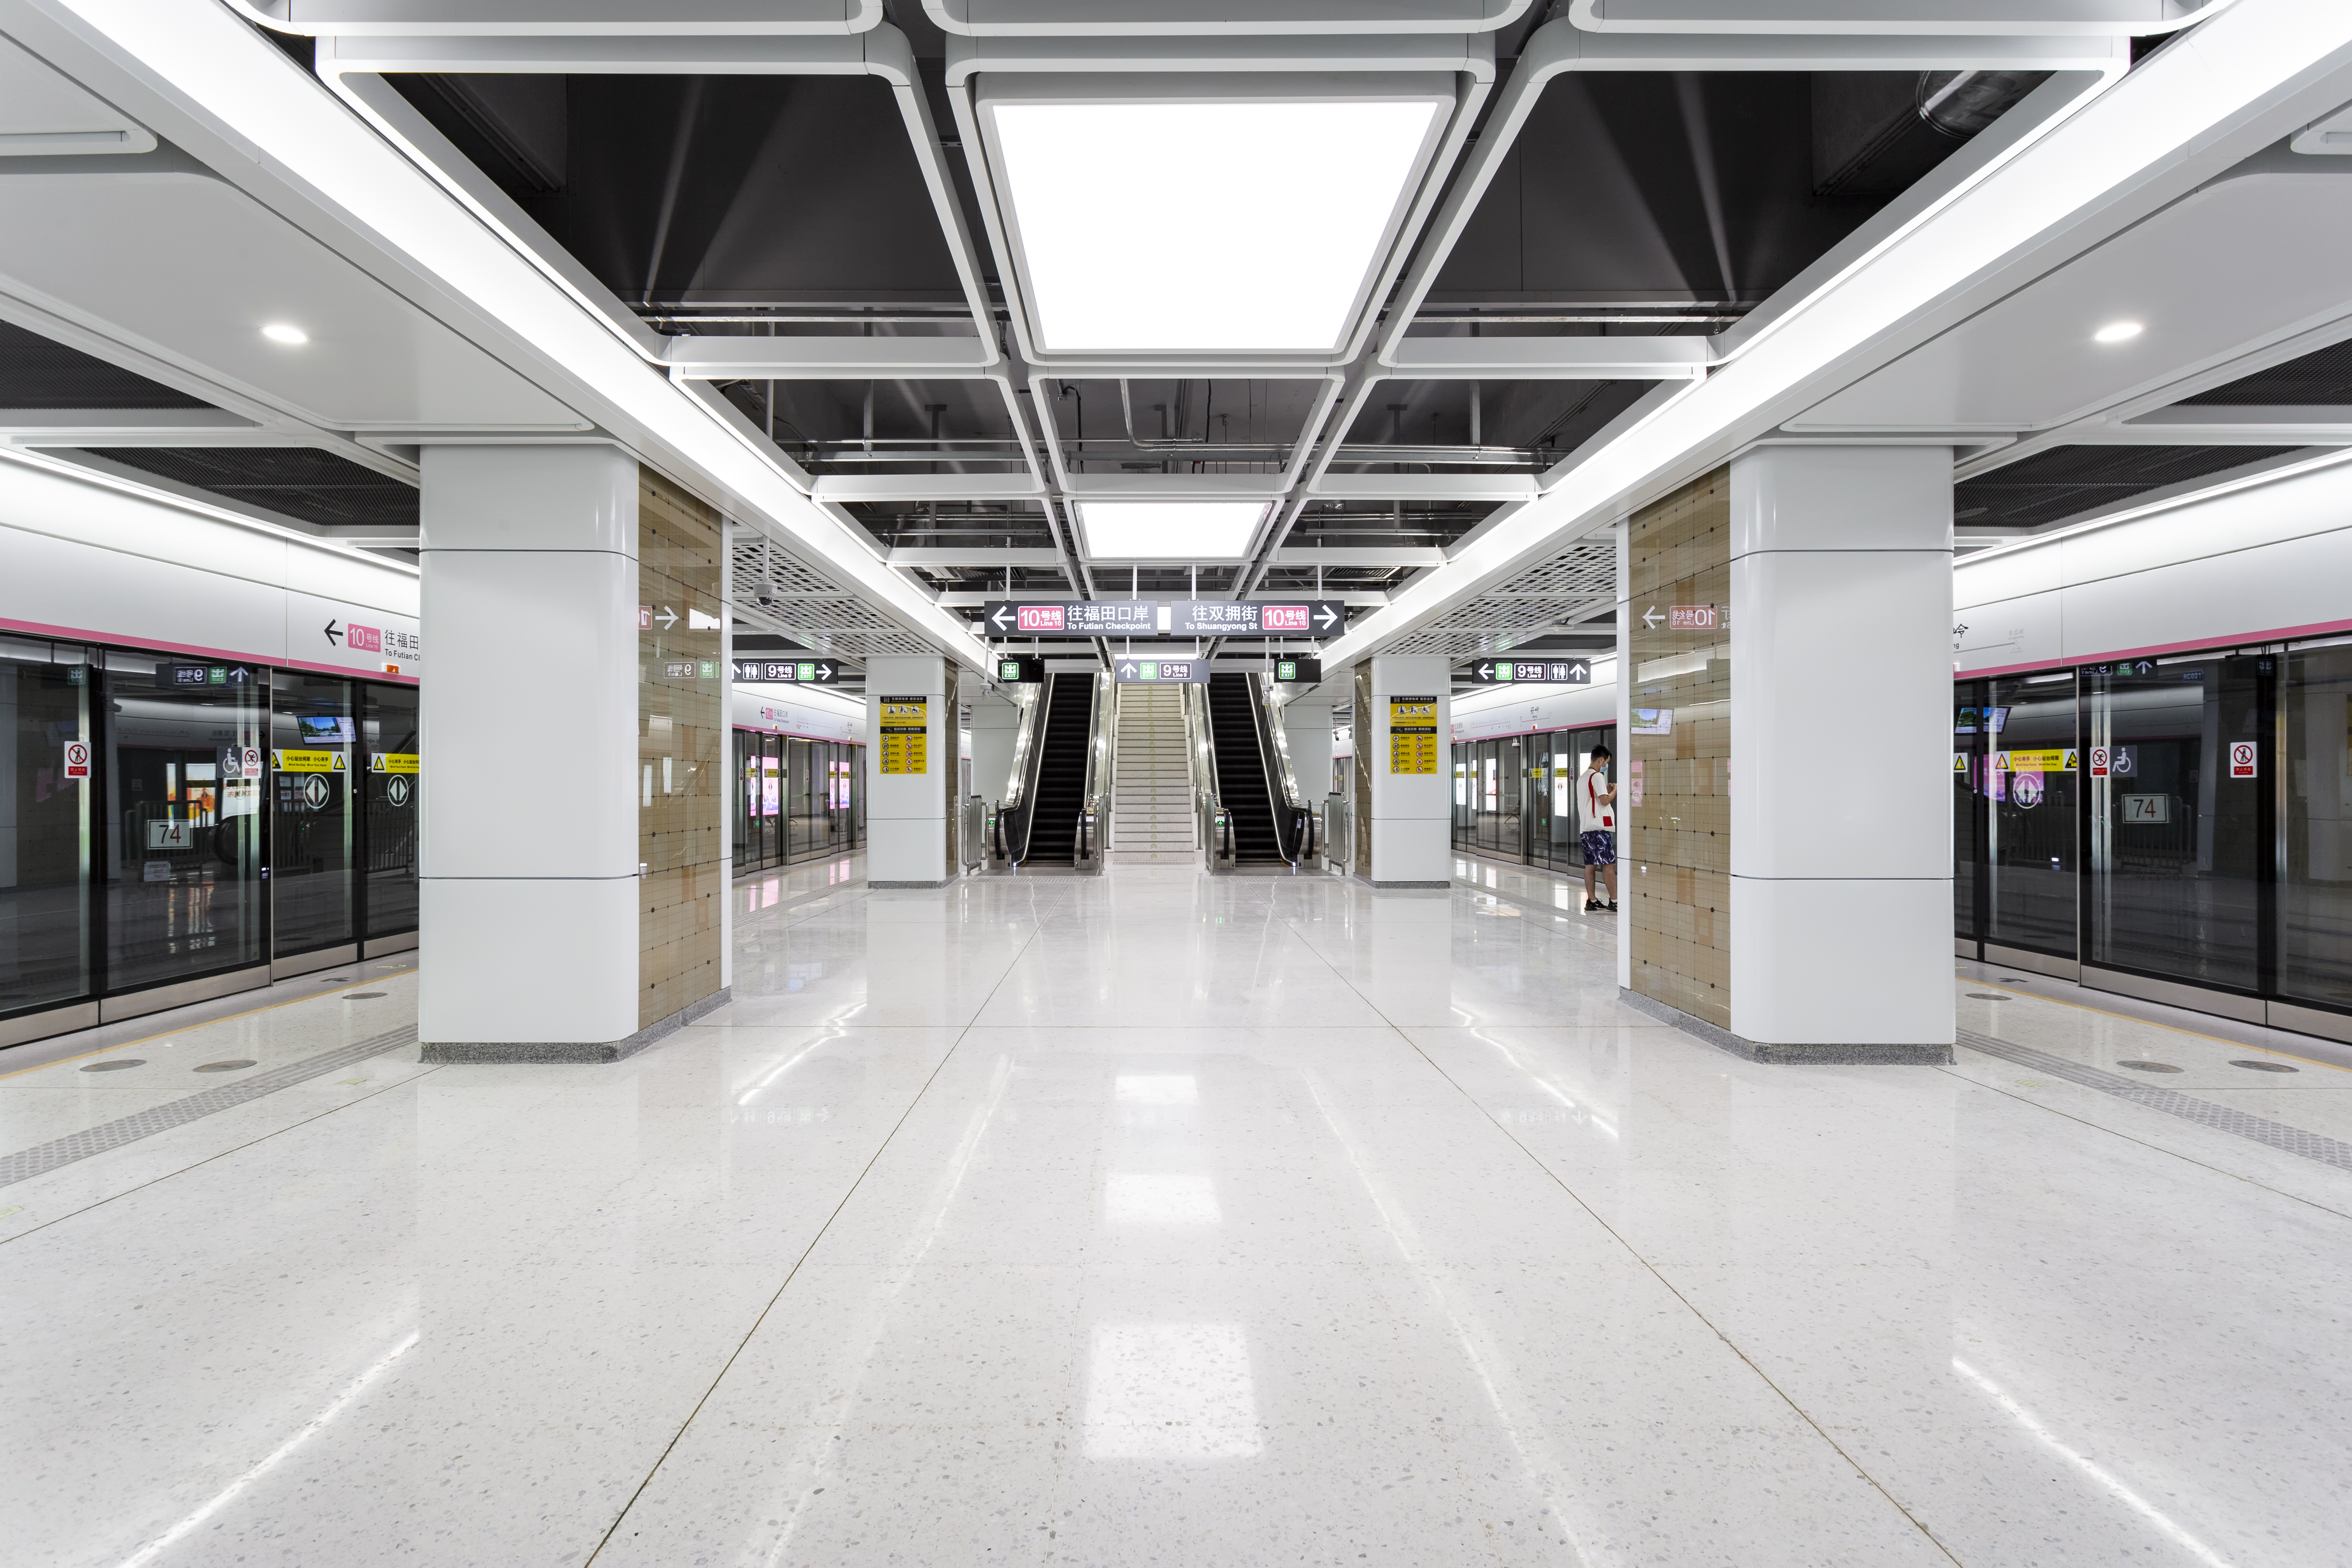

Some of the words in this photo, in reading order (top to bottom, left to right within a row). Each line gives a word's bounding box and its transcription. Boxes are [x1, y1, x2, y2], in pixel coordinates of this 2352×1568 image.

[1020, 609, 1062, 627] 10号线
[1067, 605, 1149, 621] 往福田口岸
[1192, 605, 1258, 621] 往双拥街
[1265, 609, 1306, 626] 10号线
[1105, 622, 1151, 631] Checkpoint
[1197, 622, 1247, 631] Shuangyong
[350, 627, 379, 646] 10号线
[394, 650, 412, 660] Futian
[768, 665, 792, 677] 9号线
[800, 665, 812, 674] 出
[1004, 665, 1016, 674] 出
[1142, 665, 1154, 673] 出
[1163, 665, 1188, 676] 9号线
[1281, 664, 1293, 673] 出
[1498, 665, 1510, 674] 出
[1518, 665, 1542, 677] 9号线
[2133, 799, 2156, 818] 74
[159, 824, 181, 844] 74
